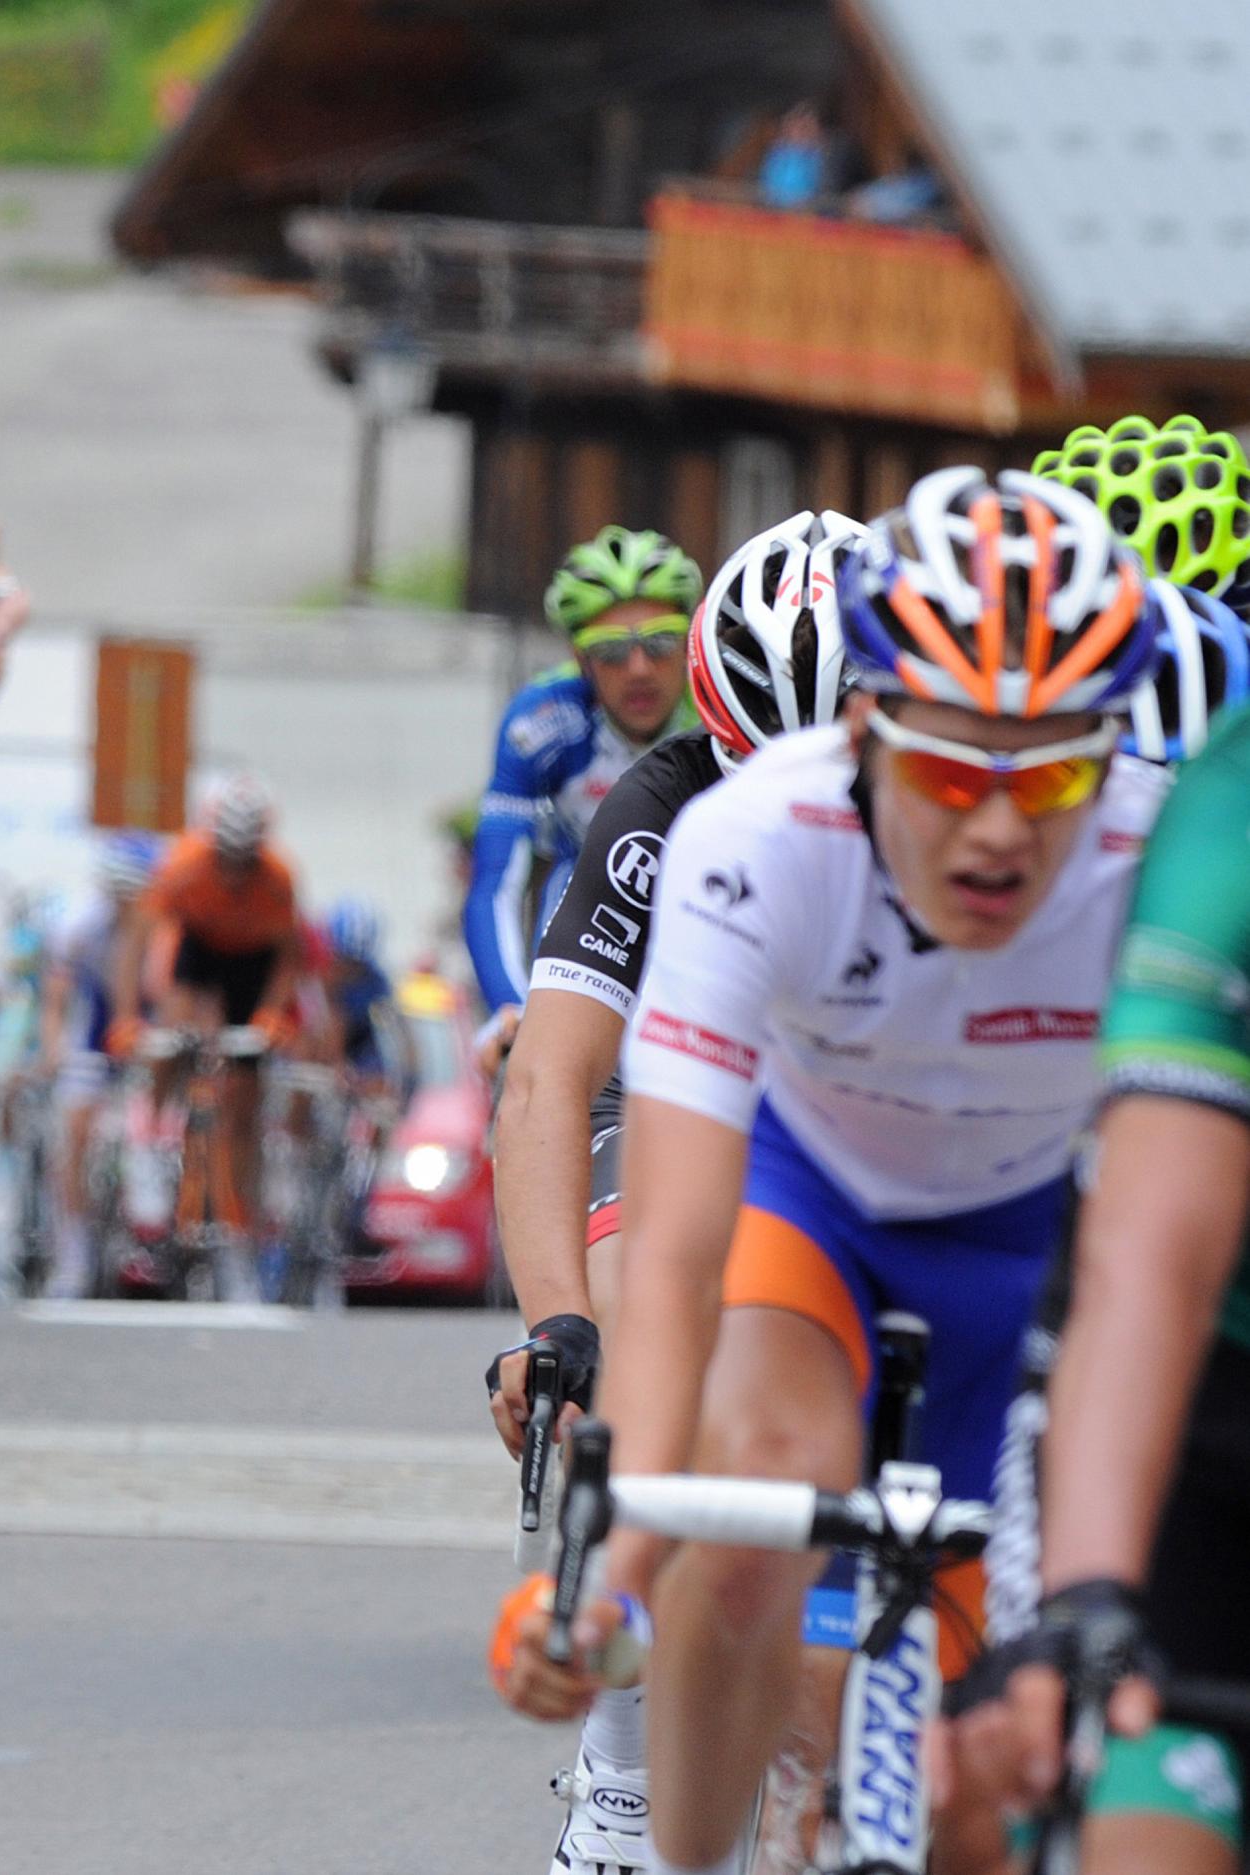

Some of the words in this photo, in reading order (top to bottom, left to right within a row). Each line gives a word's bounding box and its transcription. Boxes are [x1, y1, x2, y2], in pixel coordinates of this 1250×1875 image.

[579, 933, 629, 967] CAME
[548, 963, 581, 982] true
[584, 975, 632, 1009] racing
